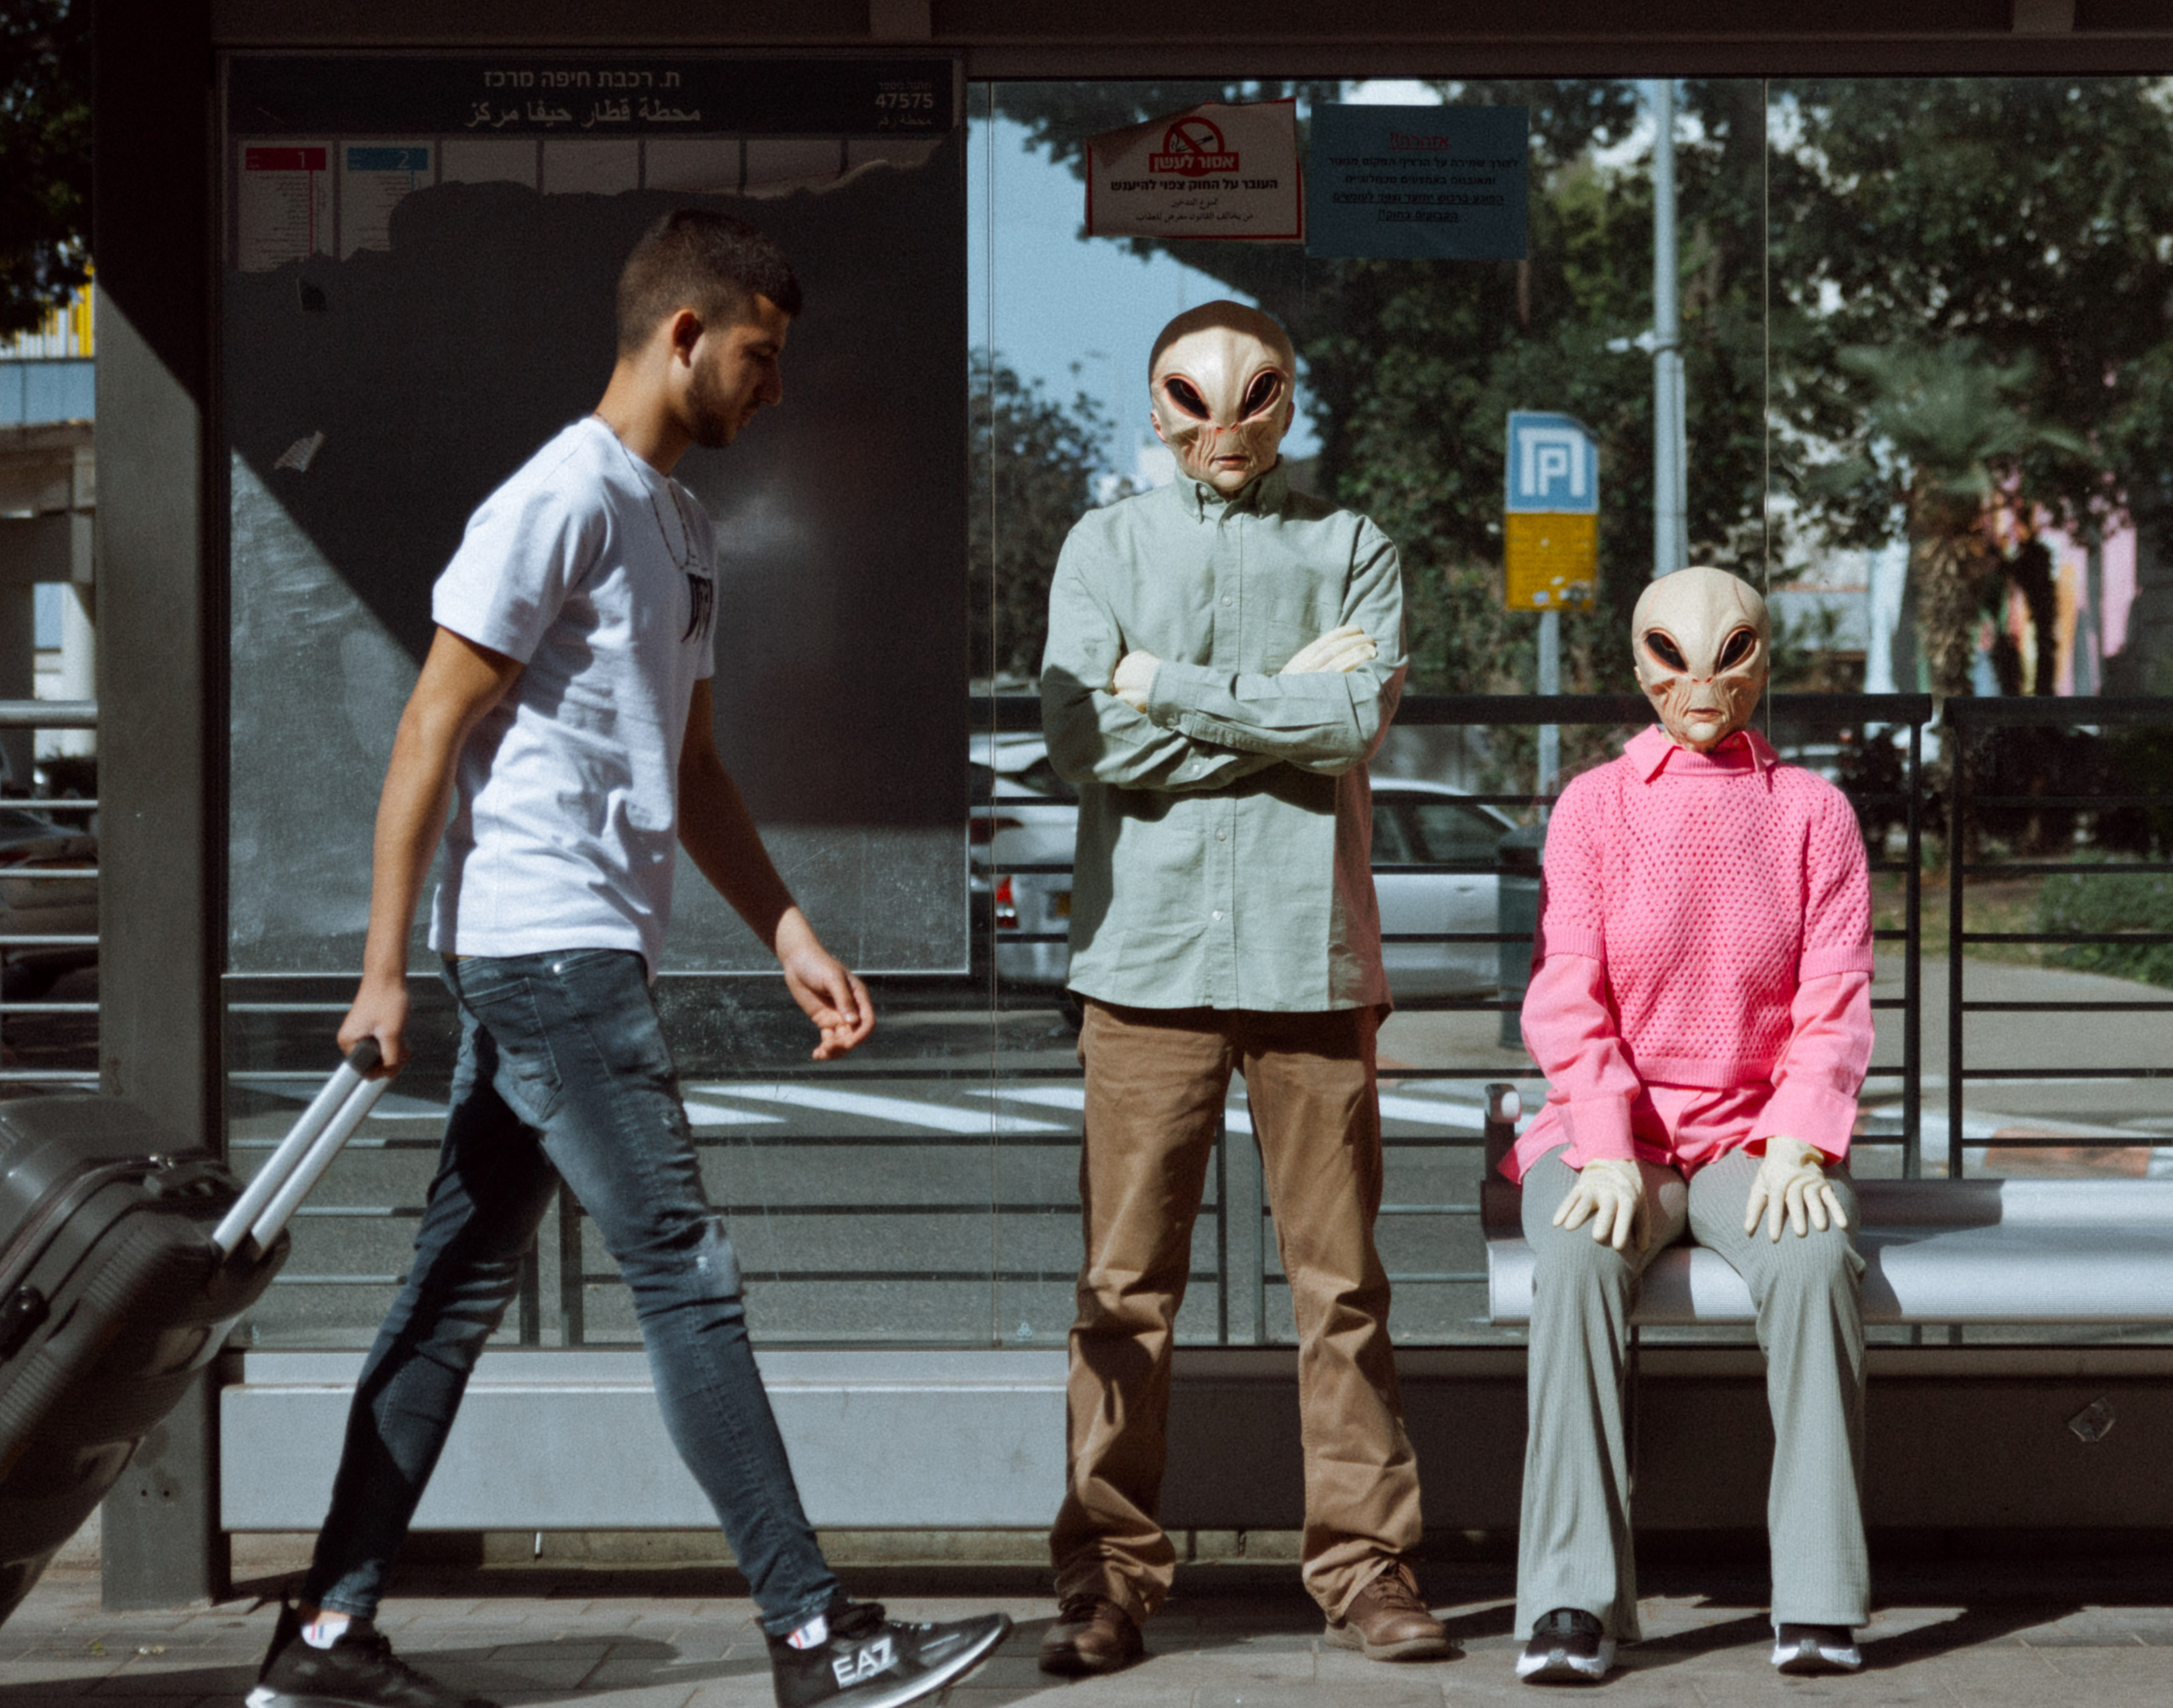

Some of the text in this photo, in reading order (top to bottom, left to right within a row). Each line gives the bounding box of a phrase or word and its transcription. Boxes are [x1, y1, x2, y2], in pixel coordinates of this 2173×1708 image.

[484, 71, 534, 87] מרכז
[541, 71, 590, 87] חיפה
[598, 71, 653, 87] רכבת
[874, 93, 934, 109] 47575
[464, 96, 702, 128] محطة قطار حيفا مركز
[298, 151, 306, 168] 1
[397, 150, 411, 168] 2
[1154, 154, 1234, 171] אסור לעשן
[1111, 177, 1278, 192] העובר על החוק צפוי להיענש
[1538, 447, 1569, 497] P
[832, 1635, 892, 1683] EA7
